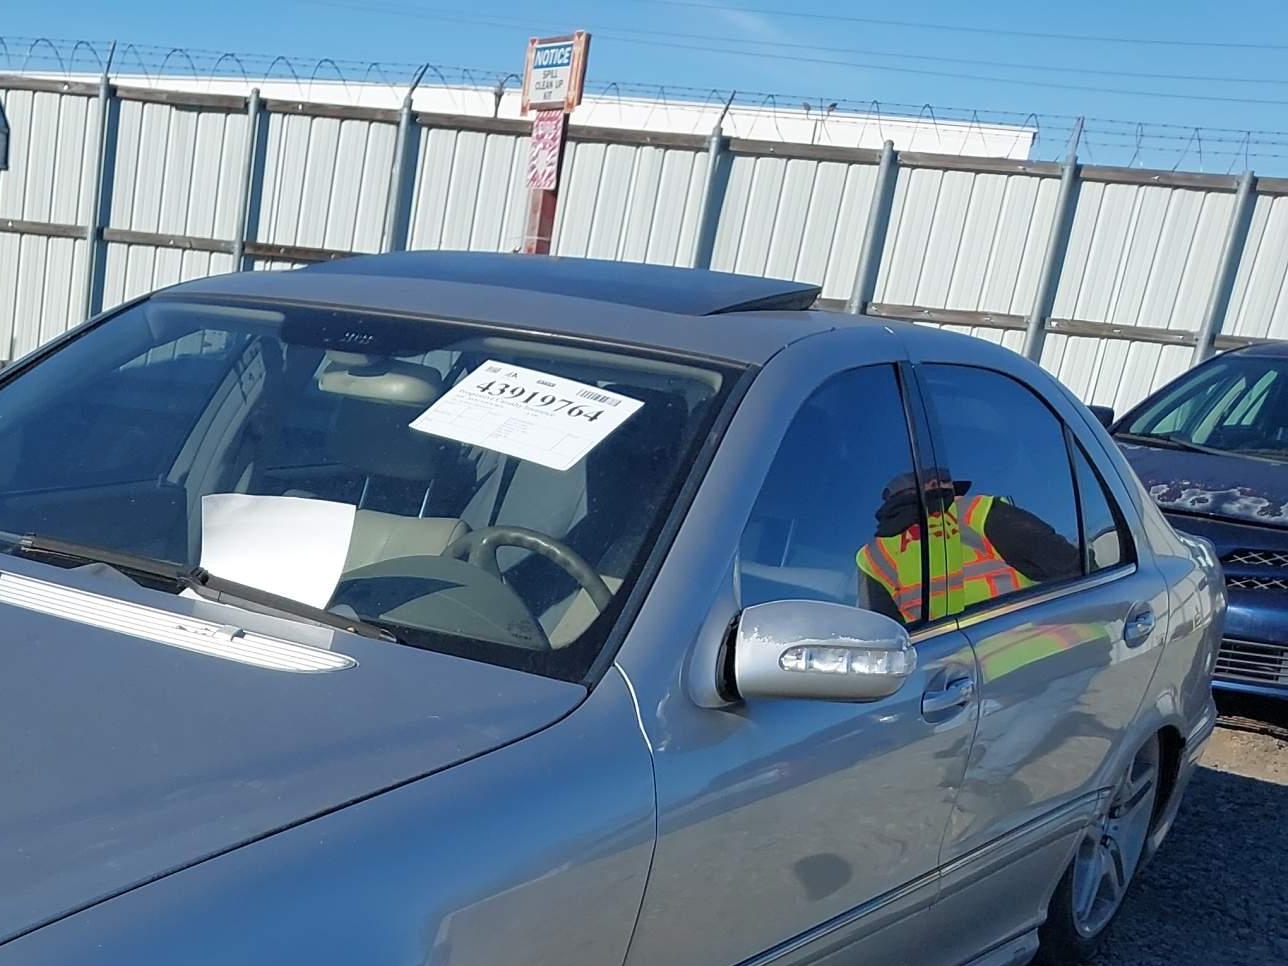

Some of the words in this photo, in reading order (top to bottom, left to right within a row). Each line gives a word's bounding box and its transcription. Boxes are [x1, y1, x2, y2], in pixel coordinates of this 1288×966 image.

[534, 47, 571, 66] NOTICE
[542, 69, 558, 79] SPILL
[535, 80, 553, 90] CLEAN
[555, 79, 563, 89] UP
[543, 91, 552, 100] KIT
[476, 380, 605, 423] 43919764
